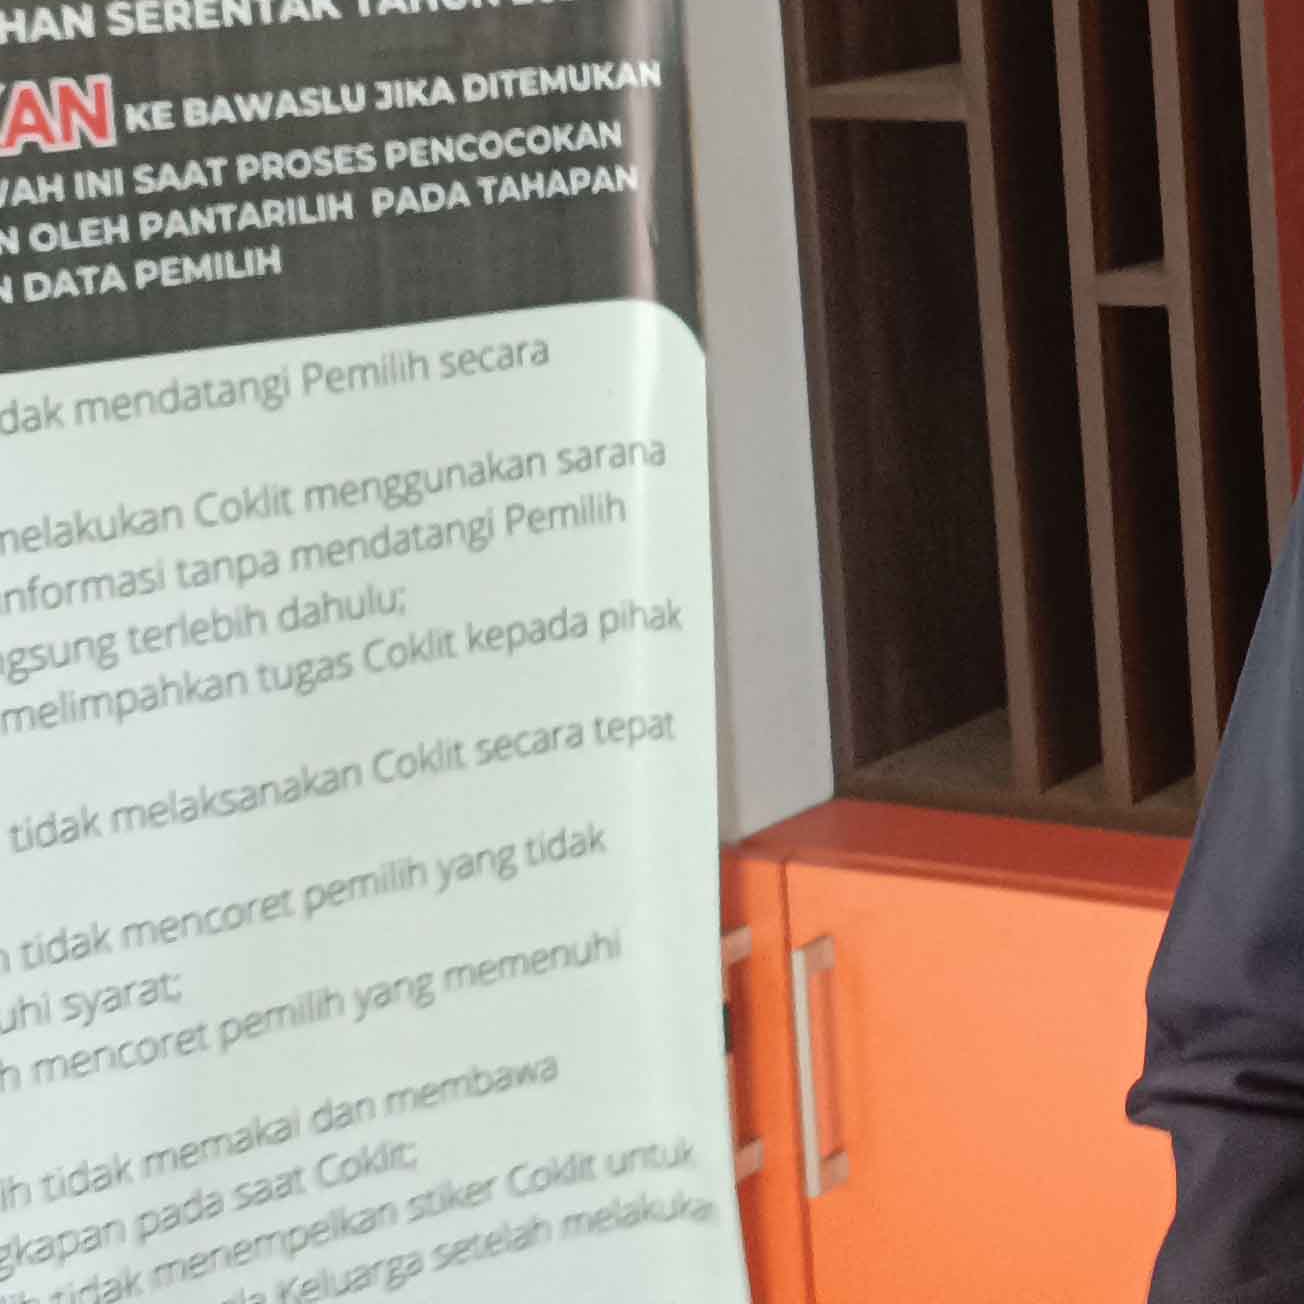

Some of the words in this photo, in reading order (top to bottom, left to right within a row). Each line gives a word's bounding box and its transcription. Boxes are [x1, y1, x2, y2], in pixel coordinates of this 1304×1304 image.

[0, 73, 117, 158] AN
[125, 100, 175, 133] KE
[182, 80, 366, 128] BAWASLU
[375, 73, 455, 111] JIKA
[463, 60, 662, 104] DITEMUKAN
[29, 214, 130, 252] OLEH
[139, 192, 354, 241] PANTARILIH
[372, 182, 471, 219] PADA
[477, 164, 639, 210] TAHAPAN
[74, 167, 124, 200] INI
[133, 156, 228, 194] SAAT
[236, 141, 377, 184] PROSES
[386, 122, 623, 172] PENCOCOKAN
[23, 264, 128, 303] DATA
[135, 244, 282, 290] PEMILIH
[74, 364, 291, 426] mendatangi
[303, 345, 430, 396] Pemilih
[438, 335, 550, 379] secara
[194, 482, 294, 528] Coklit
[304, 450, 546, 514] menggunakan
[556, 436, 667, 476] sarana
[0, 560, 165, 615] nformasi
[177, 548, 280, 589] tanpa
[290, 514, 496, 570] mendatangi
[505, 491, 628, 538] Pemilih
[0, 629, 118, 685] gsung
[127, 604, 266, 657] terlebih
[278, 583, 407, 634] dahulu;
[1, 668, 248, 735] melimpahkan
[256, 651, 354, 696] tugas
[363, 630, 458, 675] Coklit
[466, 605, 589, 656] kepada
[599, 596, 683, 642] pihak
[9, 803, 101, 853] tidak
[111, 759, 363, 833] melaksanakan
[372, 739, 465, 785] Coklit
[476, 722, 584, 764] secara
[595, 708, 676, 747] tepat
[20, 920, 112, 971] tidak
[120, 888, 295, 949] mencoret
[303, 857, 428, 920] pemilih
[434, 843, 519, 898] yang
[525, 823, 607, 866] tidak
[31, 1020, 210, 1086] mencoret
[218, 984, 346, 1054] pemilih
[352, 973, 435, 1026] yang
[442, 929, 622, 996] memenuhi
[60, 971, 183, 1028] syarat;
[41, 1151, 134, 1203] tidak
[141, 1106, 301, 1179] memakai
[309, 1096, 375, 1135] dan
[383, 1051, 559, 1116] membawa
[134, 1186, 225, 1245] pada
[231, 1164, 309, 1212] saat
[150, 1200, 398, 1290] menempelkan
[406, 1176, 498, 1225] stiker
[506, 1151, 598, 1198] Coklit
[607, 1135, 695, 1178] untuk
[431, 1214, 552, 1273] setelah
